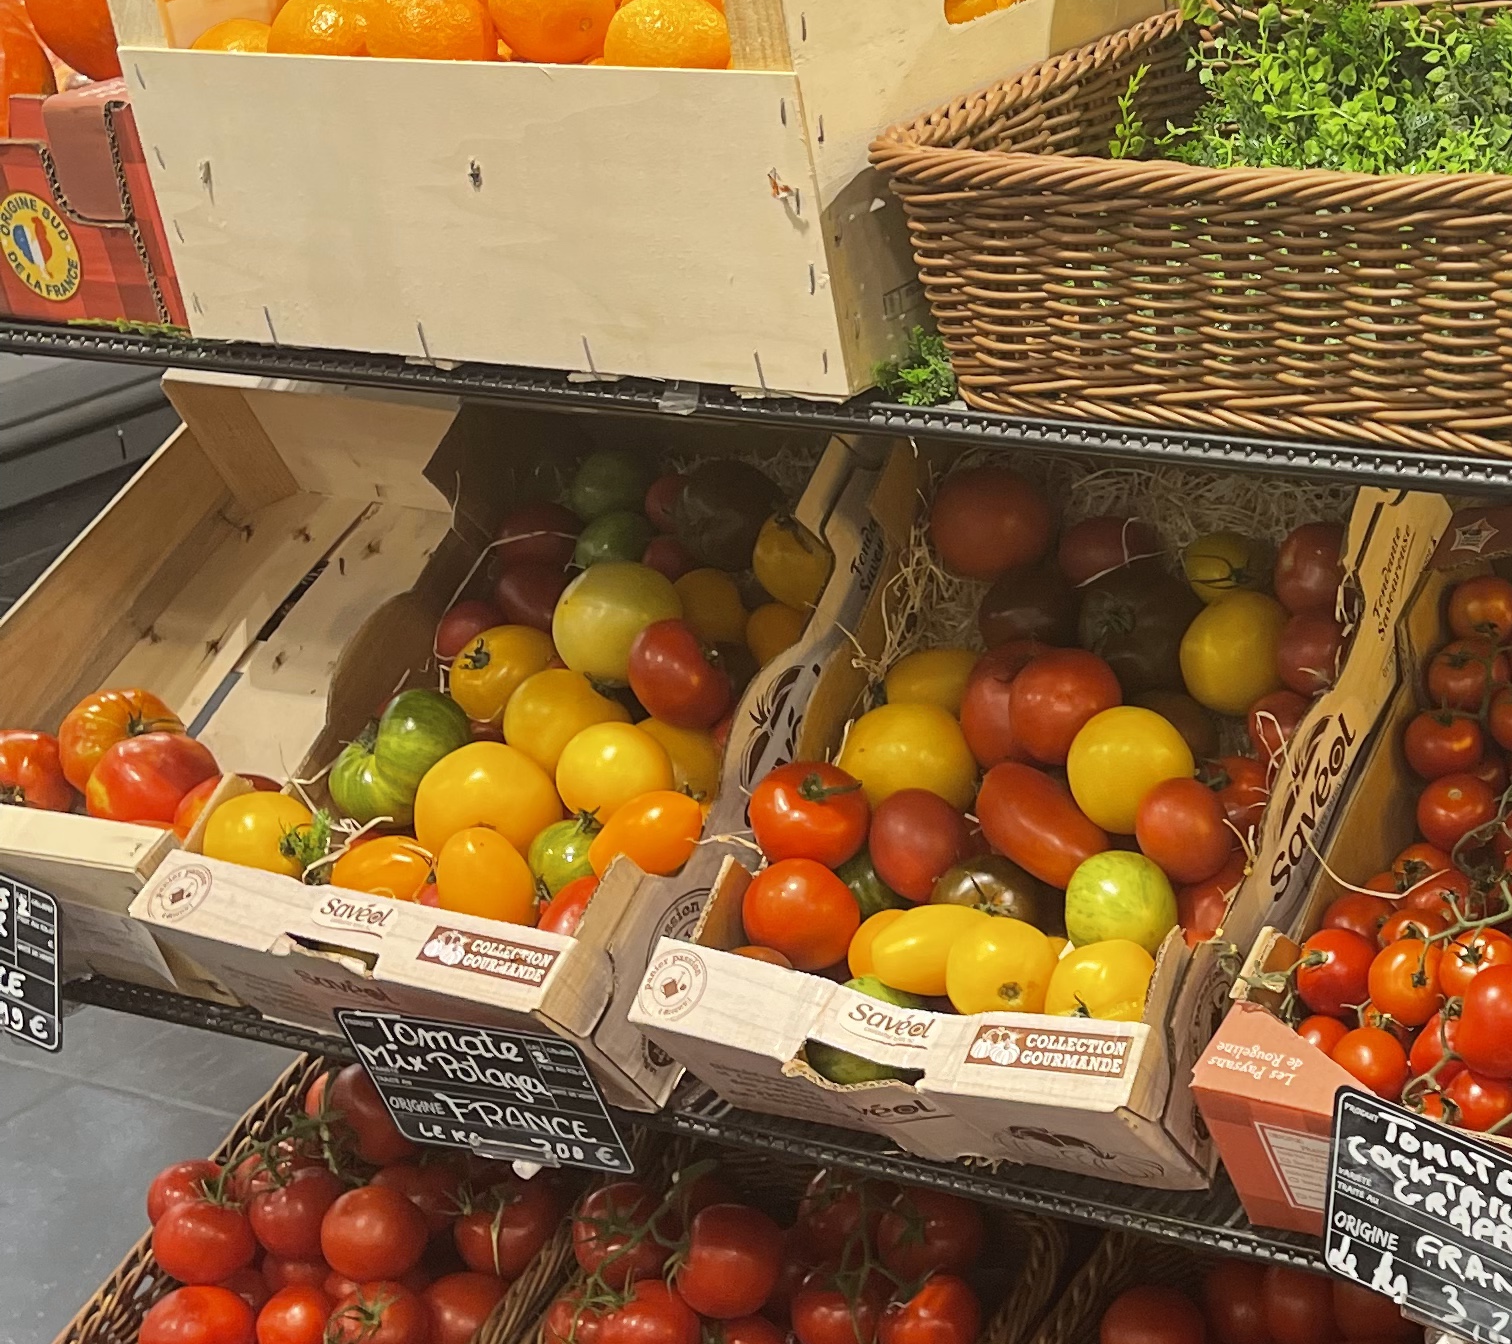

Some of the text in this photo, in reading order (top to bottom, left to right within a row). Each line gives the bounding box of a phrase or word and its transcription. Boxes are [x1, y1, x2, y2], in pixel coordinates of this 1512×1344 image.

[0, 196, 69, 242] ORIGINE SUD
[7, 251, 79, 298] DE LA FRANCE
[1372, 526, 1401, 619] Fondante
[1378, 529, 1411, 640] Savoureuse
[1269, 712, 1356, 902] Savéol
[319, 897, 394, 928] Savéol
[462, 953, 545, 984] GOURMANDE
[470, 938, 554, 967] COLLECTION
[296, 968, 392, 1002] Savéol
[645, 954, 702, 991] panier passion
[30, 1014, 48, 1040] €
[355, 1010, 524, 1062] Tomate
[848, 1002, 936, 1042] Savéol
[356, 1042, 429, 1074] Mix
[1025, 1033, 1127, 1056] COLLECTION
[1216, 1040, 1304, 1071] de Rougeline
[1019, 1052, 1123, 1074] GOURMANDE
[1207, 1055, 1297, 1086] Les Paysans
[389, 1096, 445, 1116] ORIGINE
[434, 1092, 597, 1143] FRANCE
[1344, 1102, 1379, 1123] PRODUIT
[418, 1122, 621, 1167] LE €
[1333, 1210, 1399, 1252] ORIGINE
